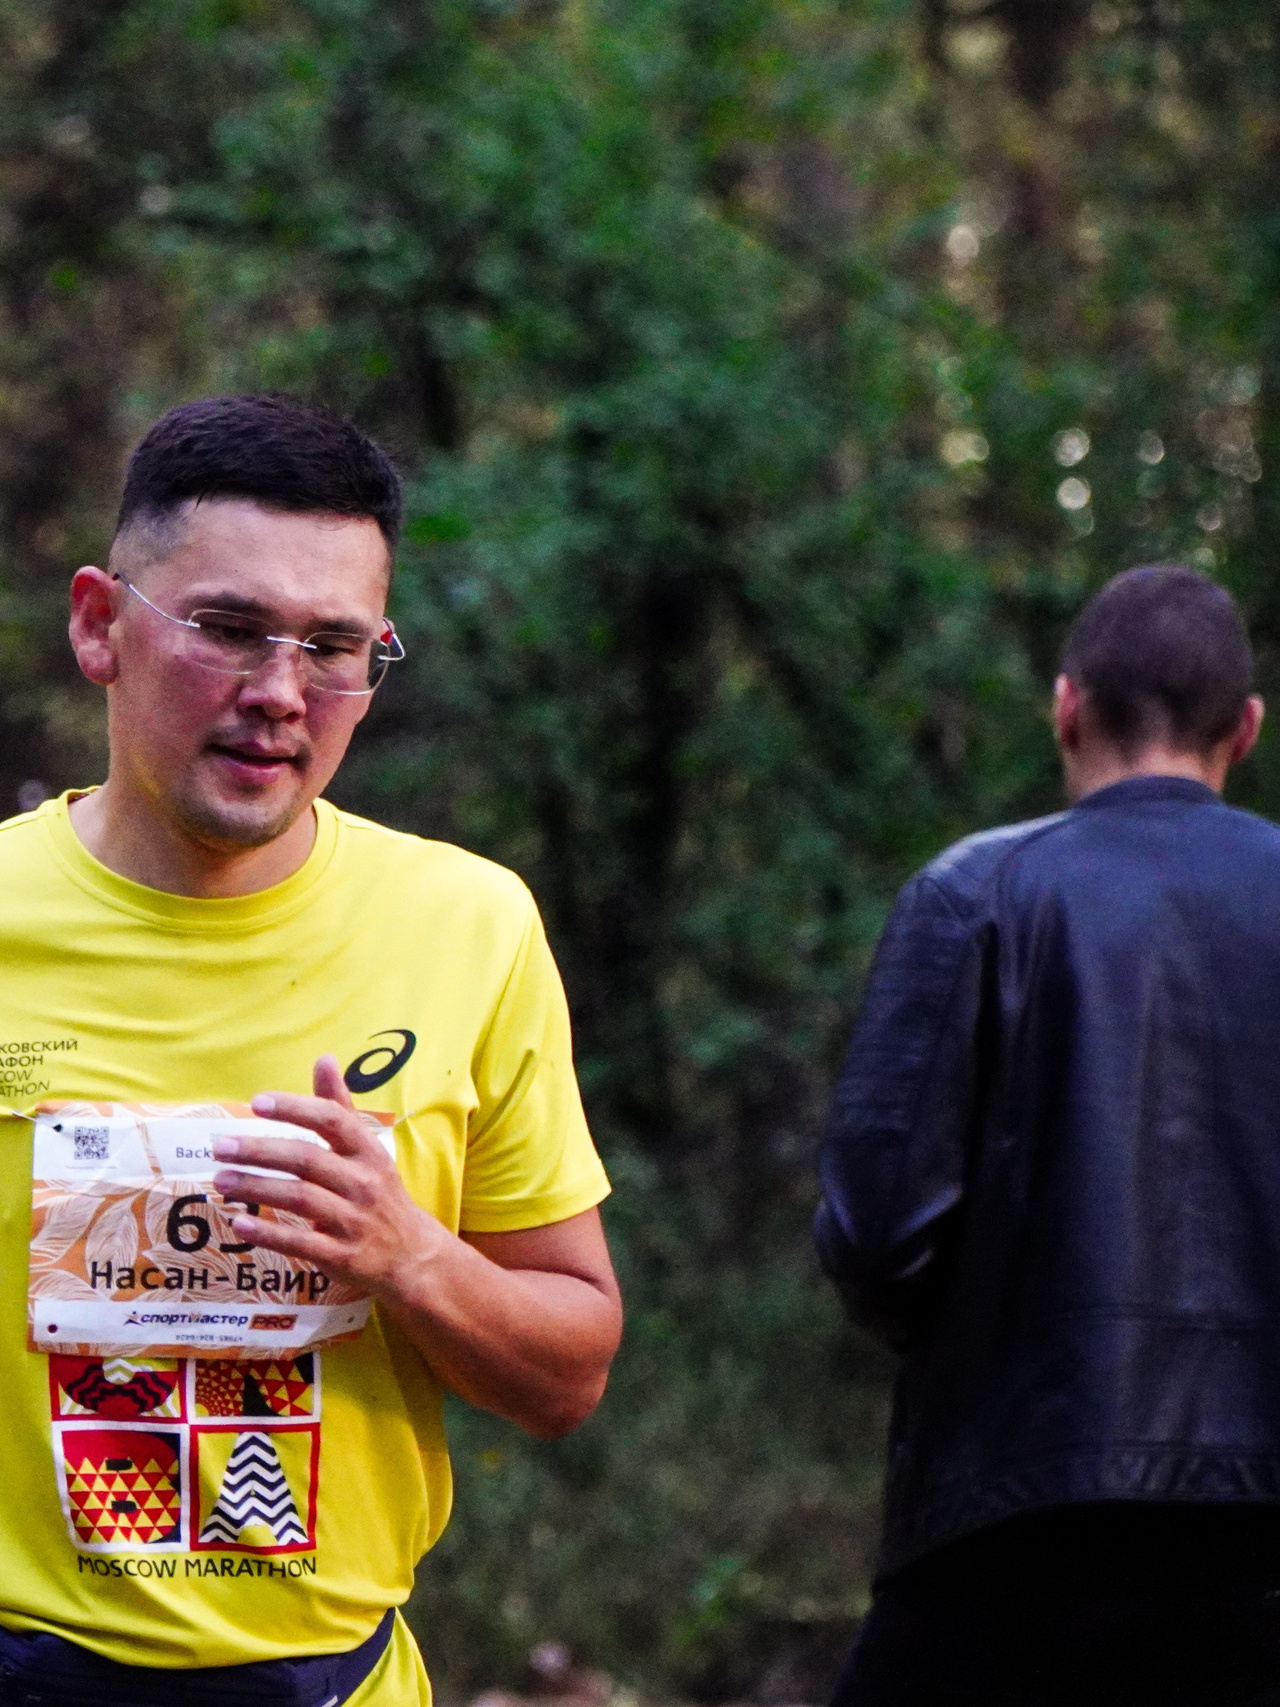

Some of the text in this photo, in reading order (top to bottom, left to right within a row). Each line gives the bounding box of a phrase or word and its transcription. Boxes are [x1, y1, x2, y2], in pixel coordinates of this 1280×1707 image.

[175, 1147, 218, 1161] Back
[90, 1261, 330, 1301] Насан-Баир
[78, 1555, 317, 1579] MOSCOW MARATHON
